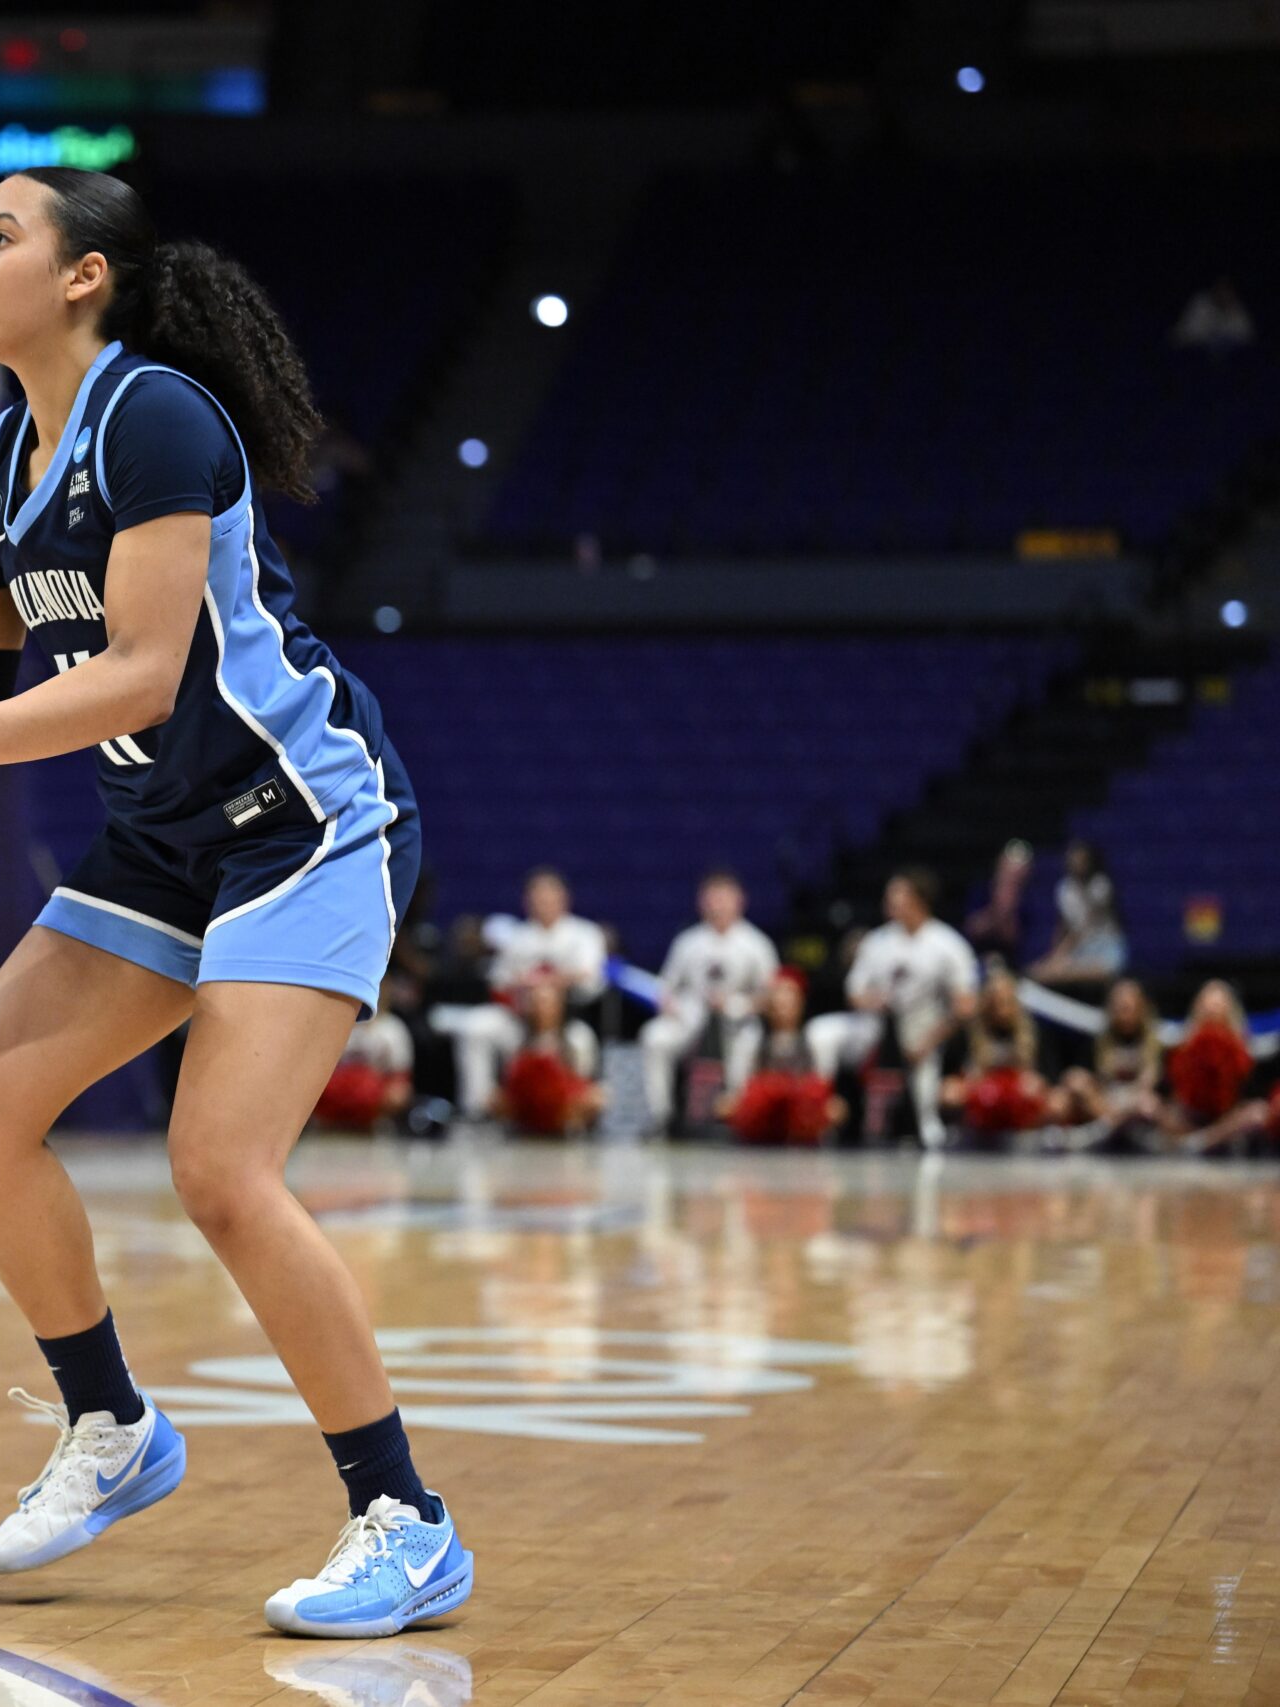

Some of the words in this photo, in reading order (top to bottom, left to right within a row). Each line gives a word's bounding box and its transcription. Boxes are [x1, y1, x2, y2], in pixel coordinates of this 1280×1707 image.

[75, 469, 88, 484] THE
[68, 480, 91, 498] ANGE
[9, 569, 106, 632] LLANOVA
[261, 788, 276, 804] M
